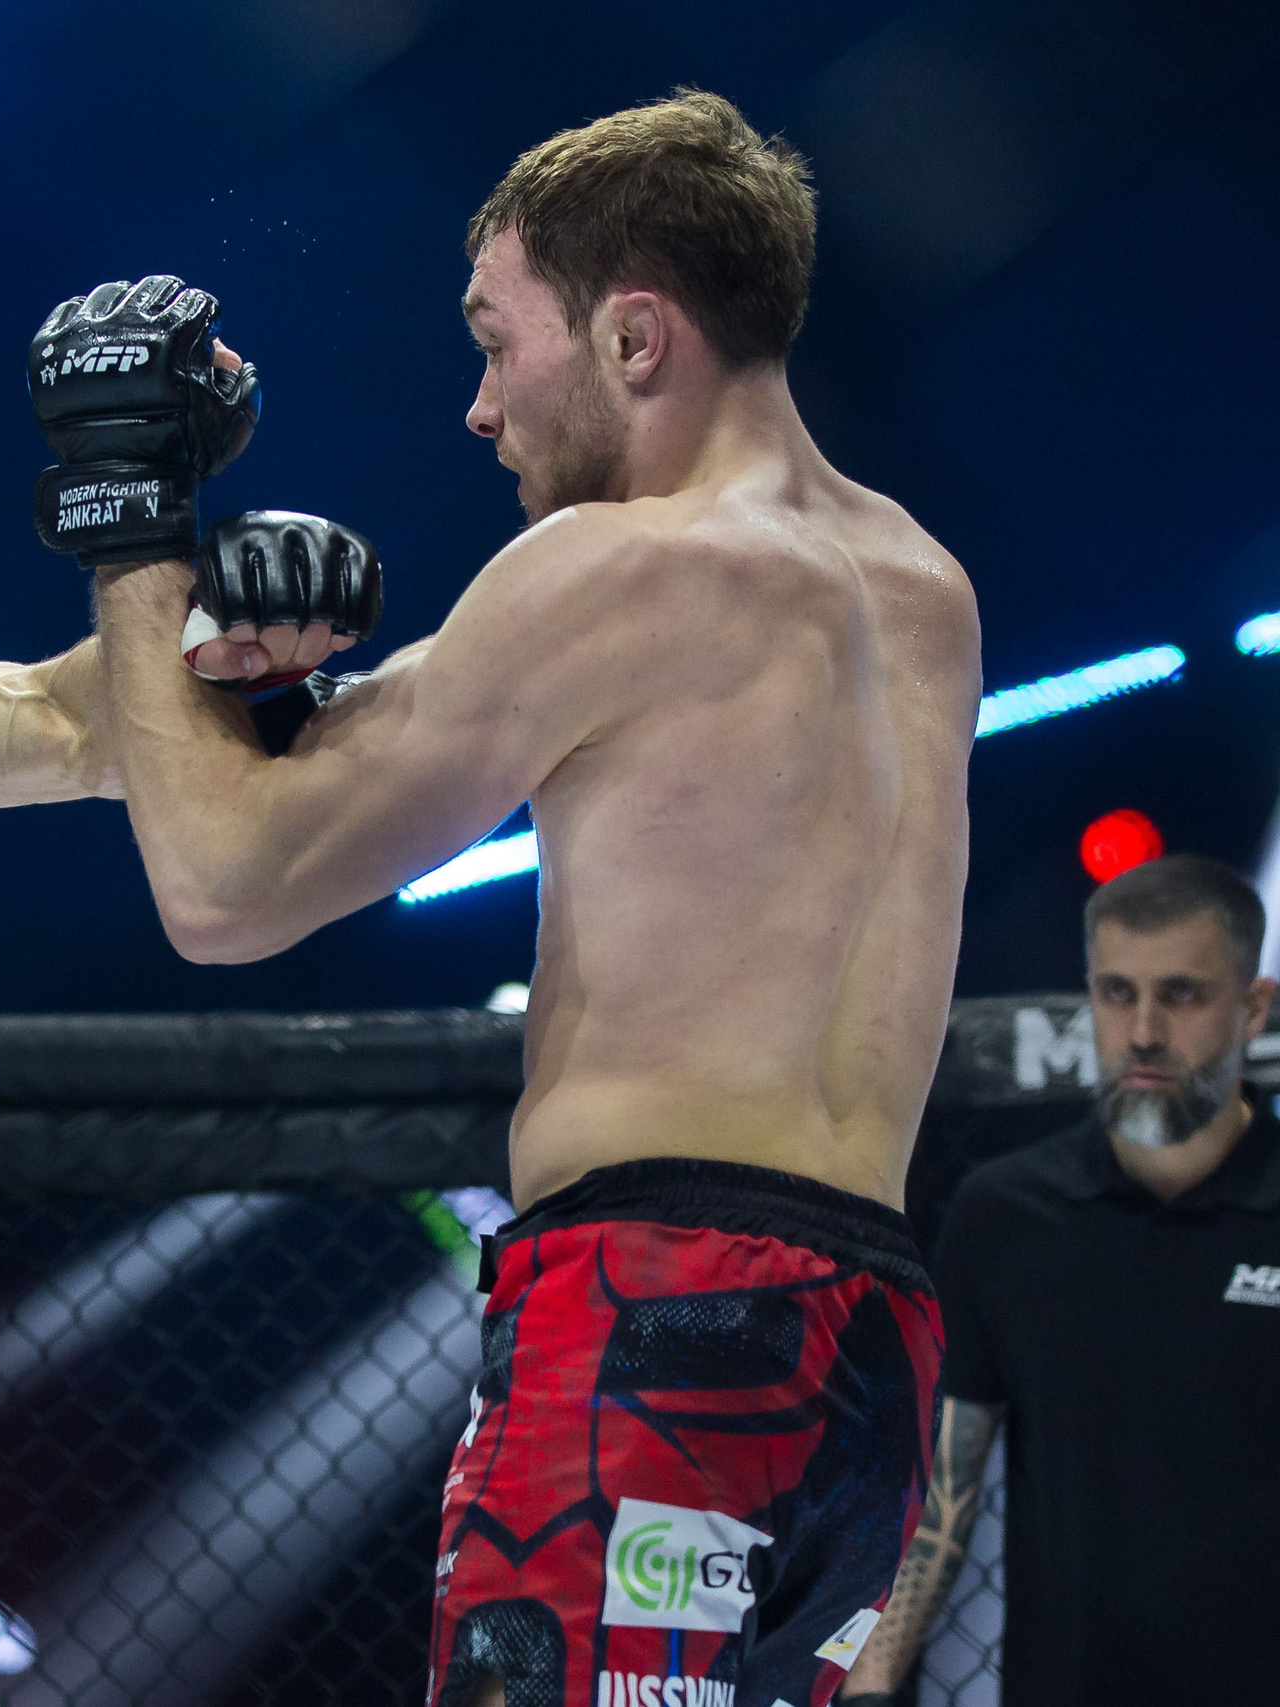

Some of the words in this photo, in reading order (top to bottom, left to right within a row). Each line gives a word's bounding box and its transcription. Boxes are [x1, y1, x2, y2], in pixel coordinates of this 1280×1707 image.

[61, 346, 149, 375] MFP
[60, 484, 99, 507] MODERN
[99, 480, 159, 499] FIGHTING
